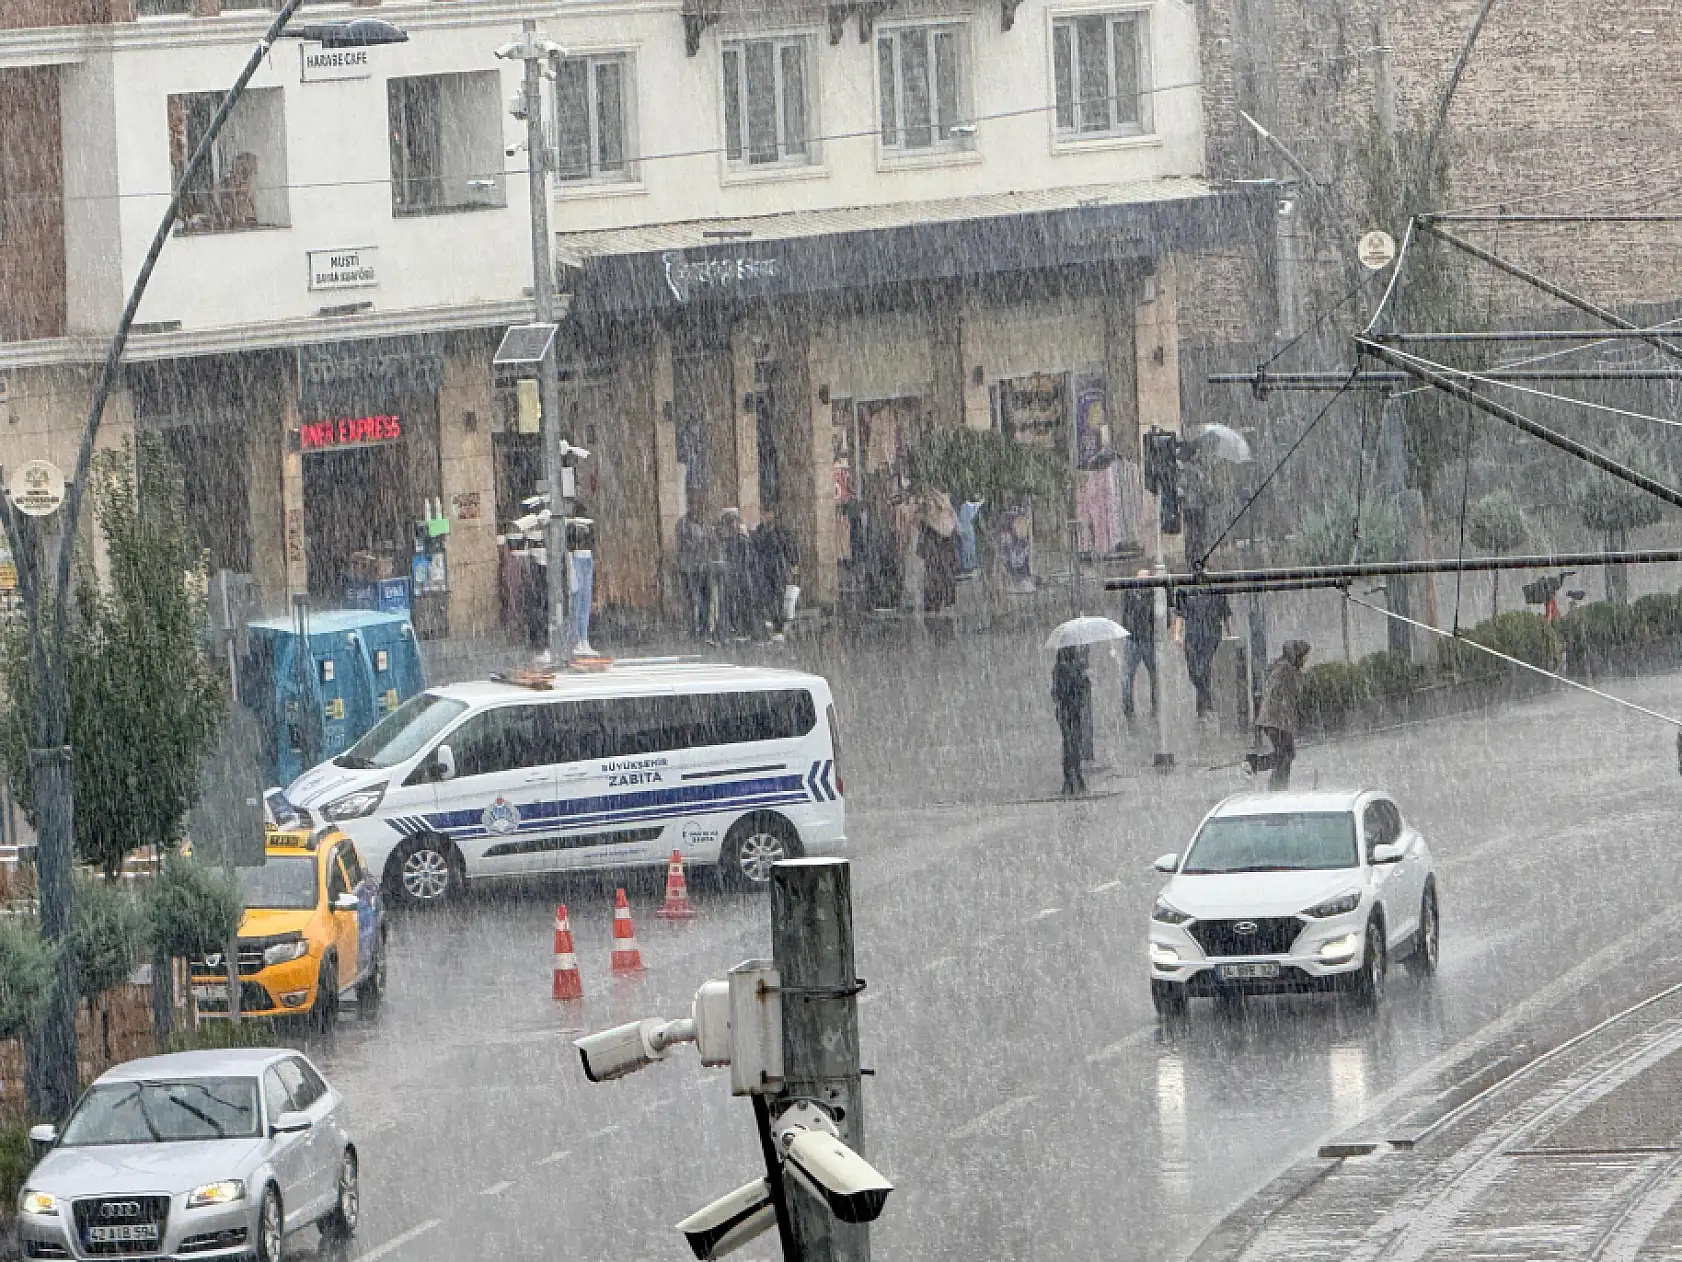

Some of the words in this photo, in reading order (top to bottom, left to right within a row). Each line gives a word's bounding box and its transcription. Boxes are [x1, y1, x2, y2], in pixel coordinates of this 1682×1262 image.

[345, 51, 367, 66] CAFE
[337, 415, 401, 444] EXPRESS
[608, 772, 663, 788] ZABITA
